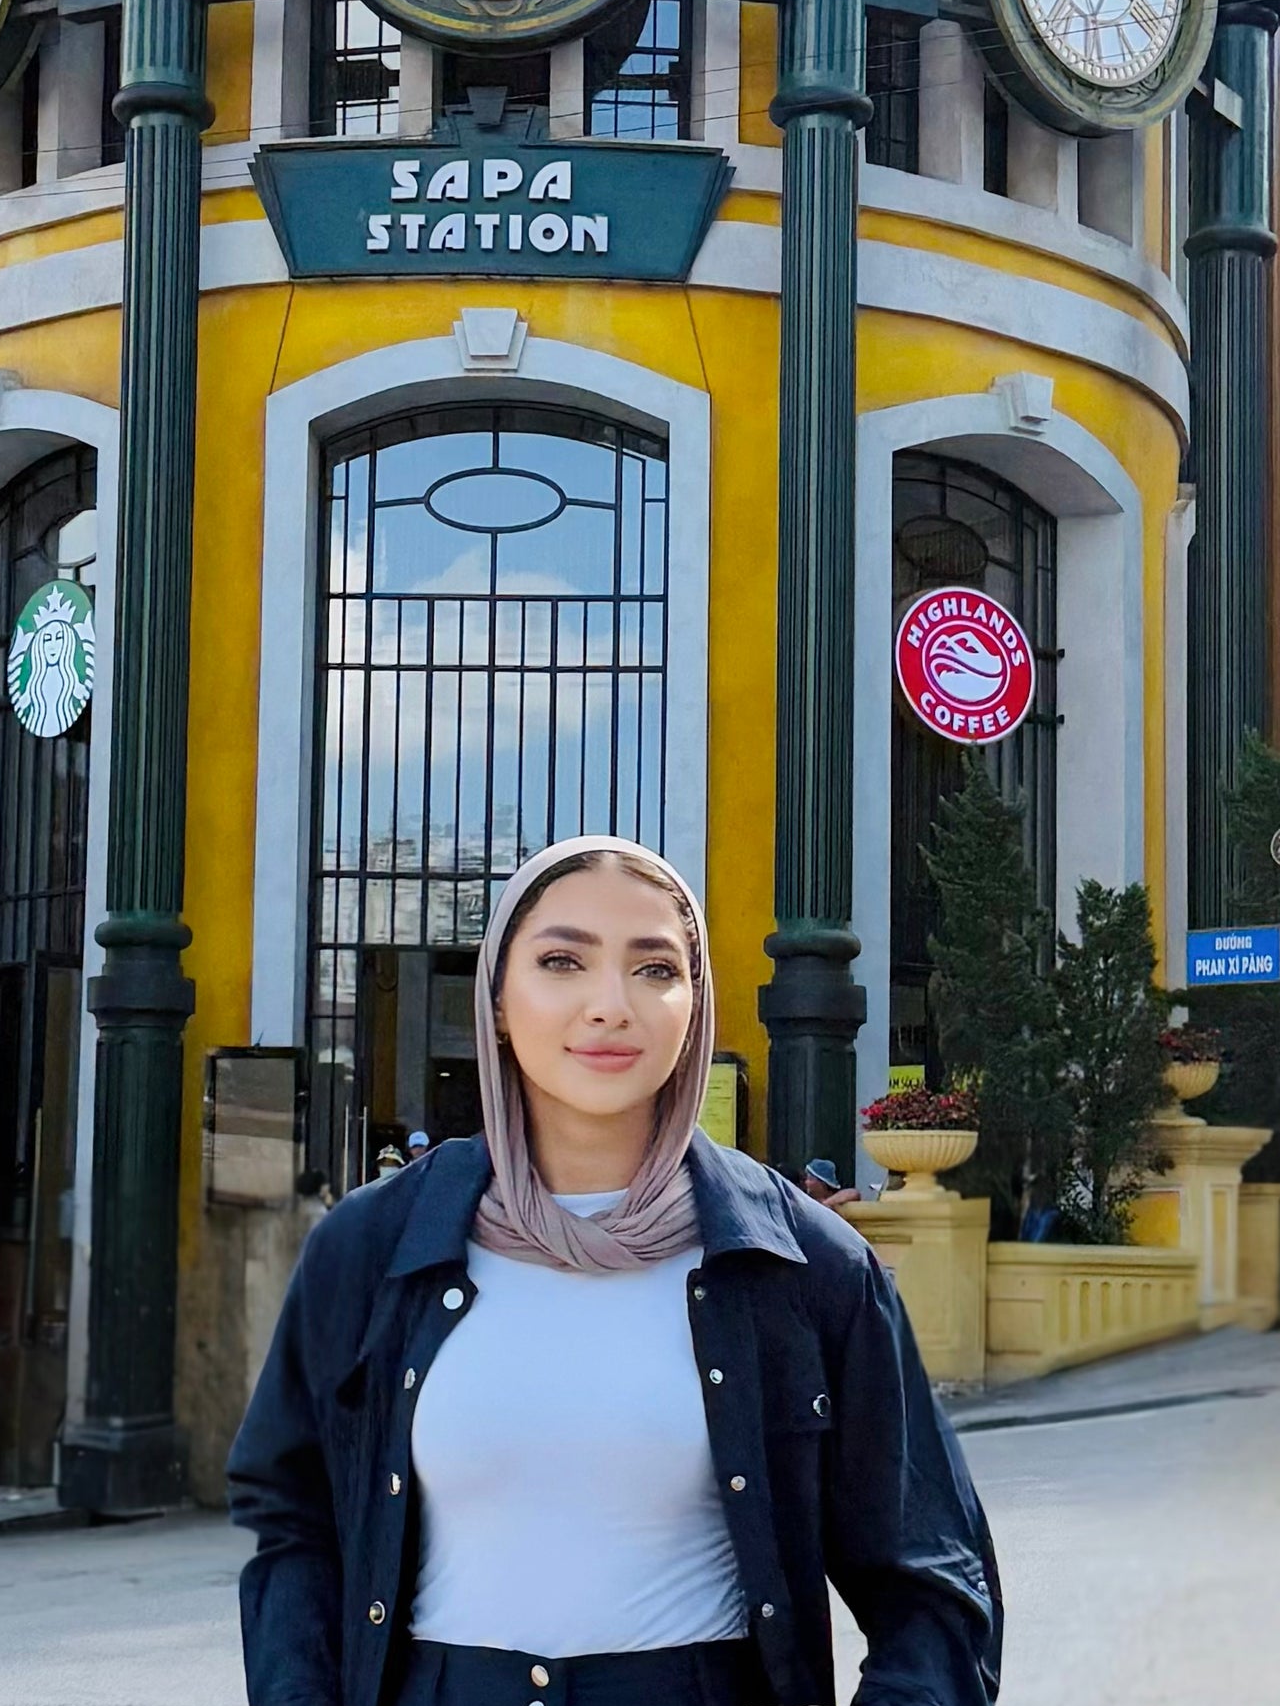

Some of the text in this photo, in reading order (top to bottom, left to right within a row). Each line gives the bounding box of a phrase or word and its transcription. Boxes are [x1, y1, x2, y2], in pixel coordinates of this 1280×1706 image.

[390, 158, 573, 201] SAPA
[366, 212, 609, 253] STATION
[906, 597, 1025, 667] HIGHLANDS
[920, 691, 1011, 734] COFFEE
[1195, 958, 1225, 976] PHAN
